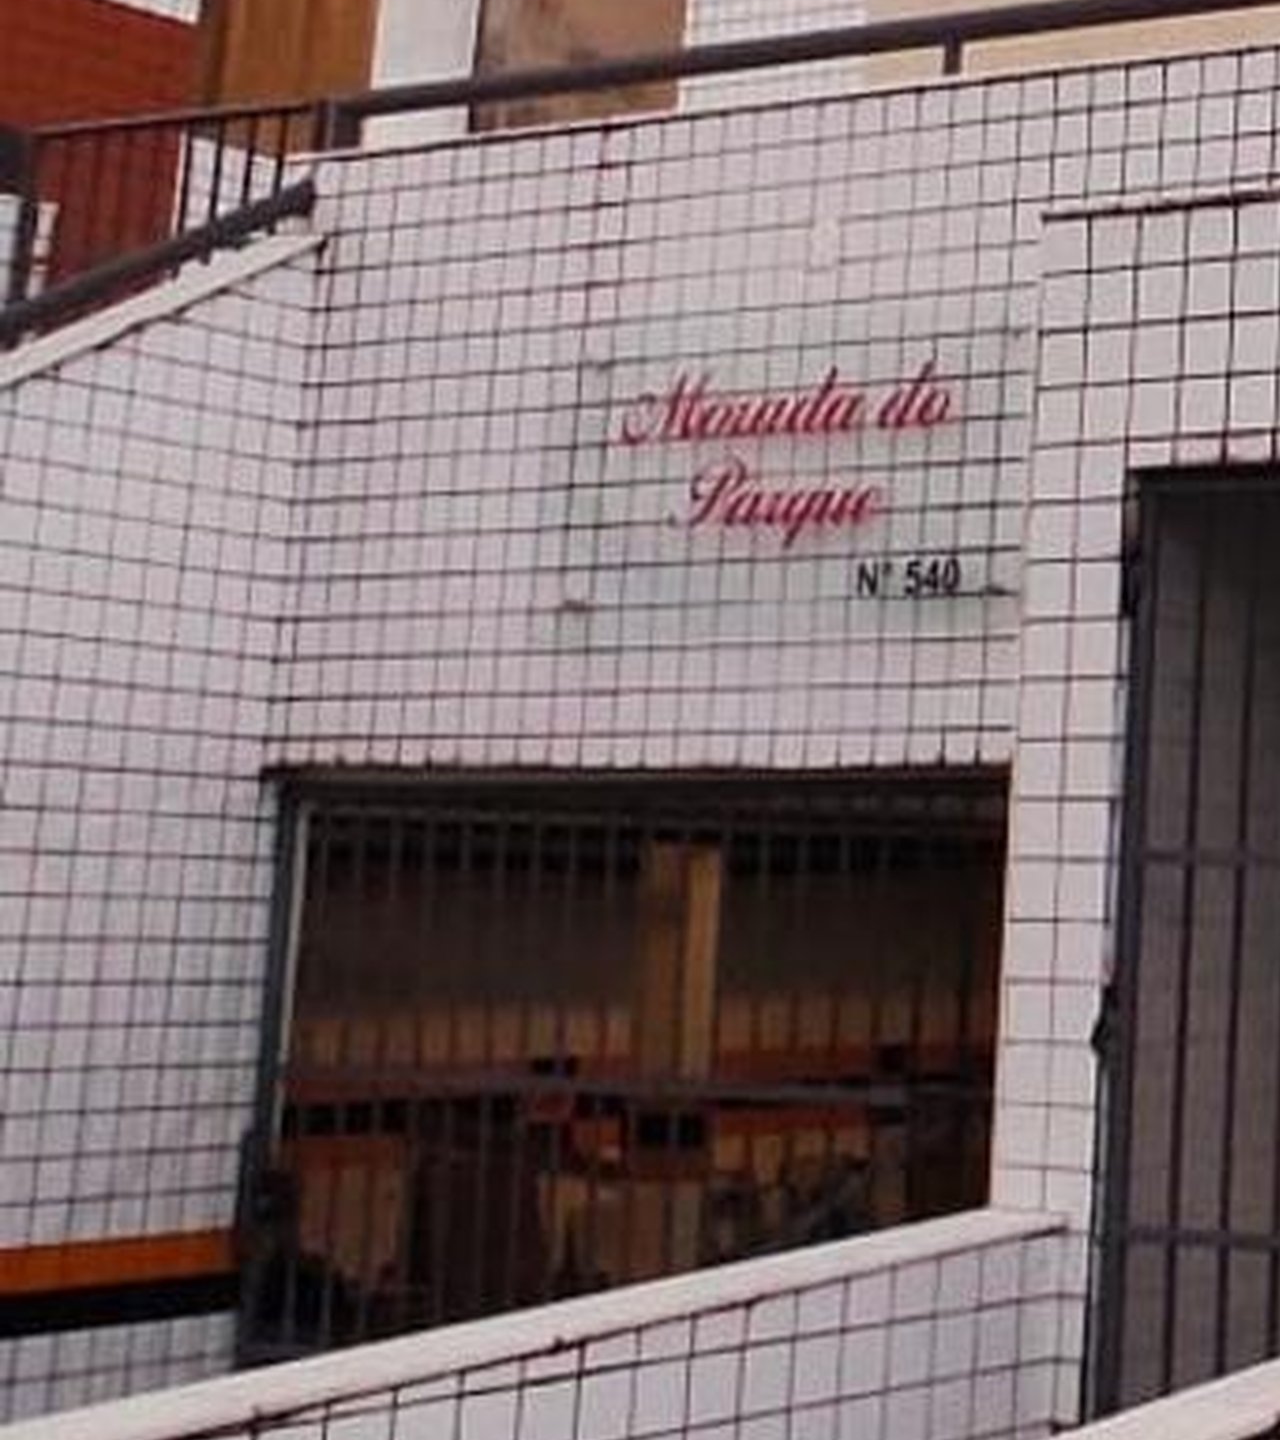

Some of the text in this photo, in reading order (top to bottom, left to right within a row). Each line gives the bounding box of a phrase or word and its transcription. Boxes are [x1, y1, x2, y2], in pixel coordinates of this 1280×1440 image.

[608, 357, 953, 447] Morada do
[904, 558, 961, 597] 540
